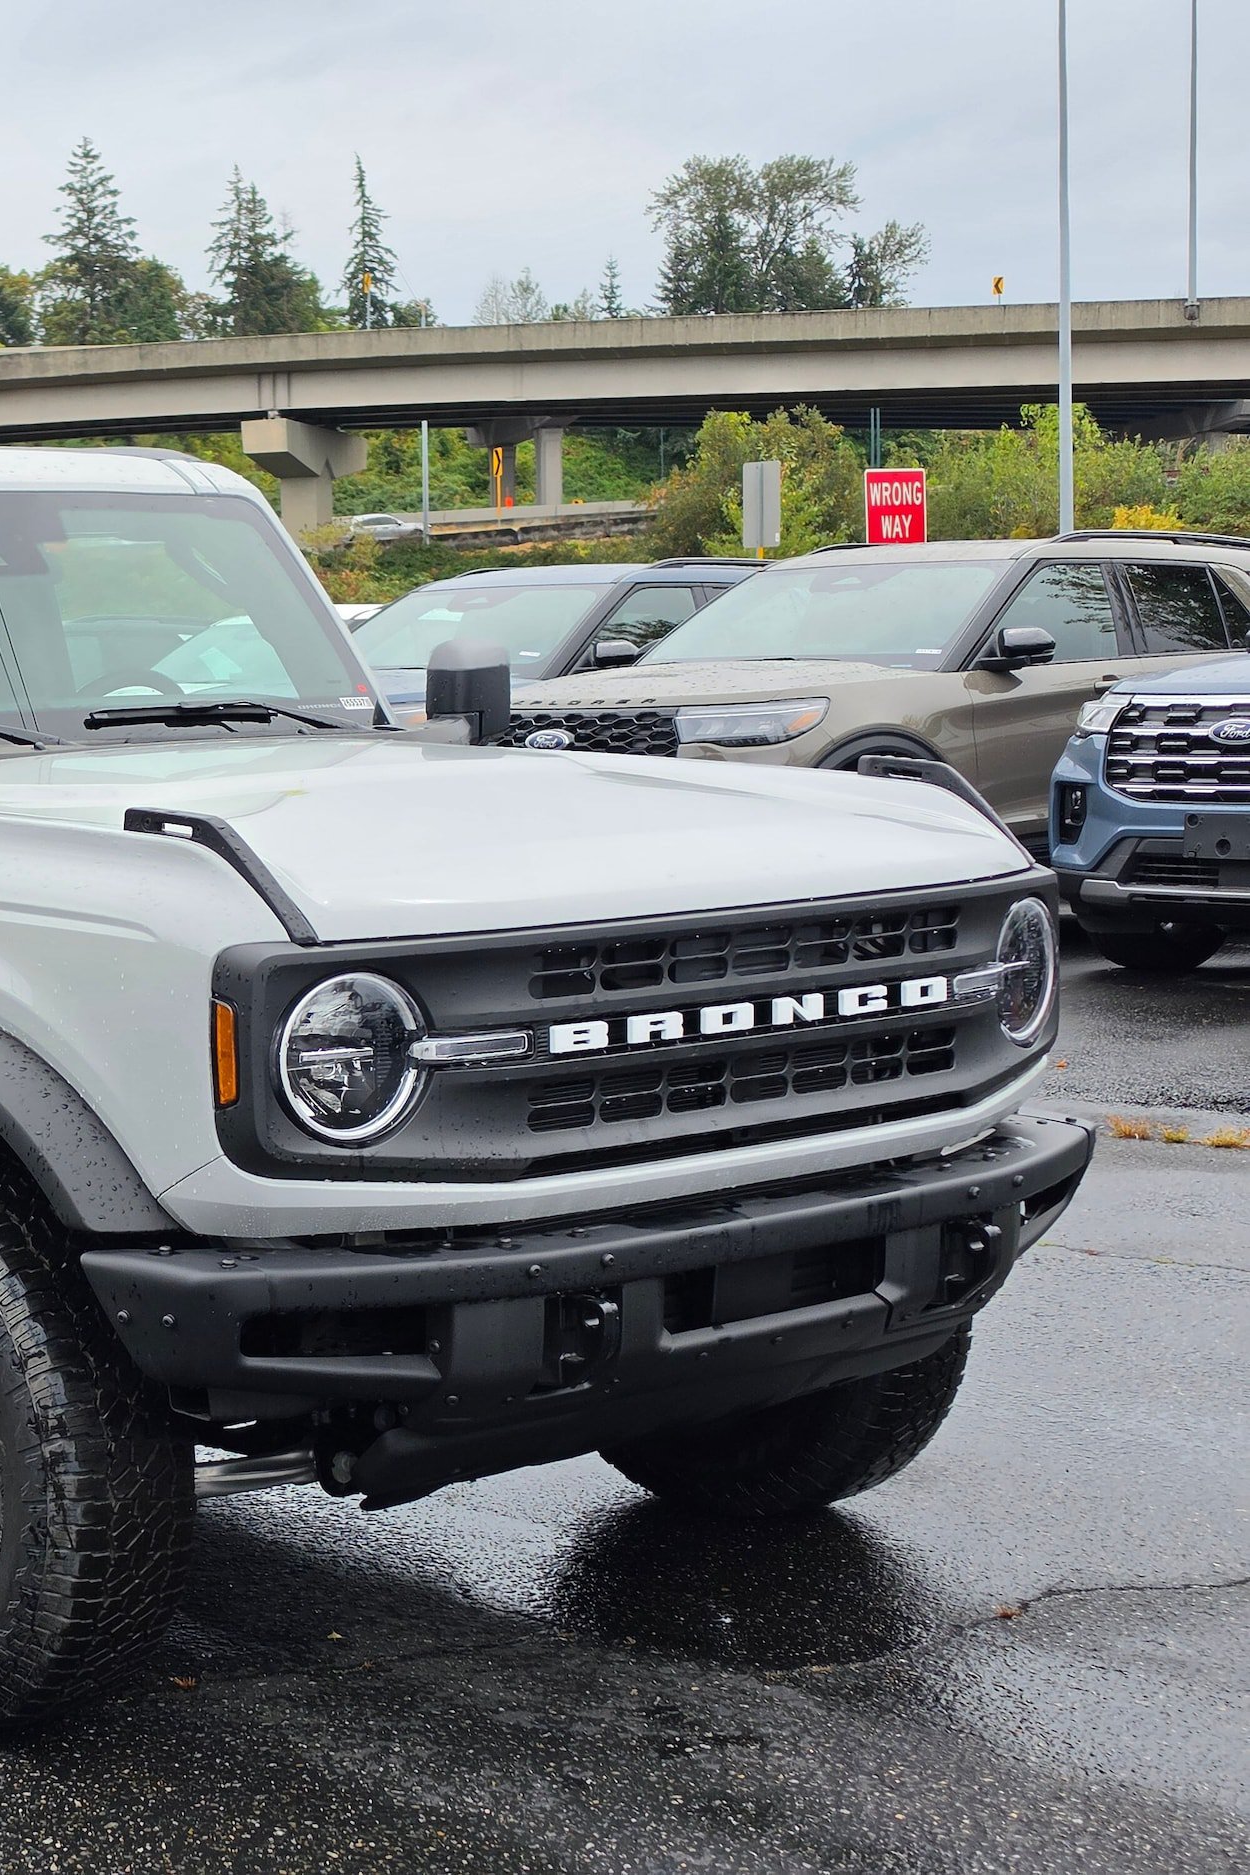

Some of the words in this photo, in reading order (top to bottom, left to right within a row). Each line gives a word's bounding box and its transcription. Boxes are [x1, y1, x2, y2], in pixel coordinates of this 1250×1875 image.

[869, 481, 922, 506] WRONG
[881, 514, 912, 539] WAY
[512, 698, 657, 706] XPLORER
[533, 734, 558, 749] Ford
[549, 976, 948, 1054] BRONCO
